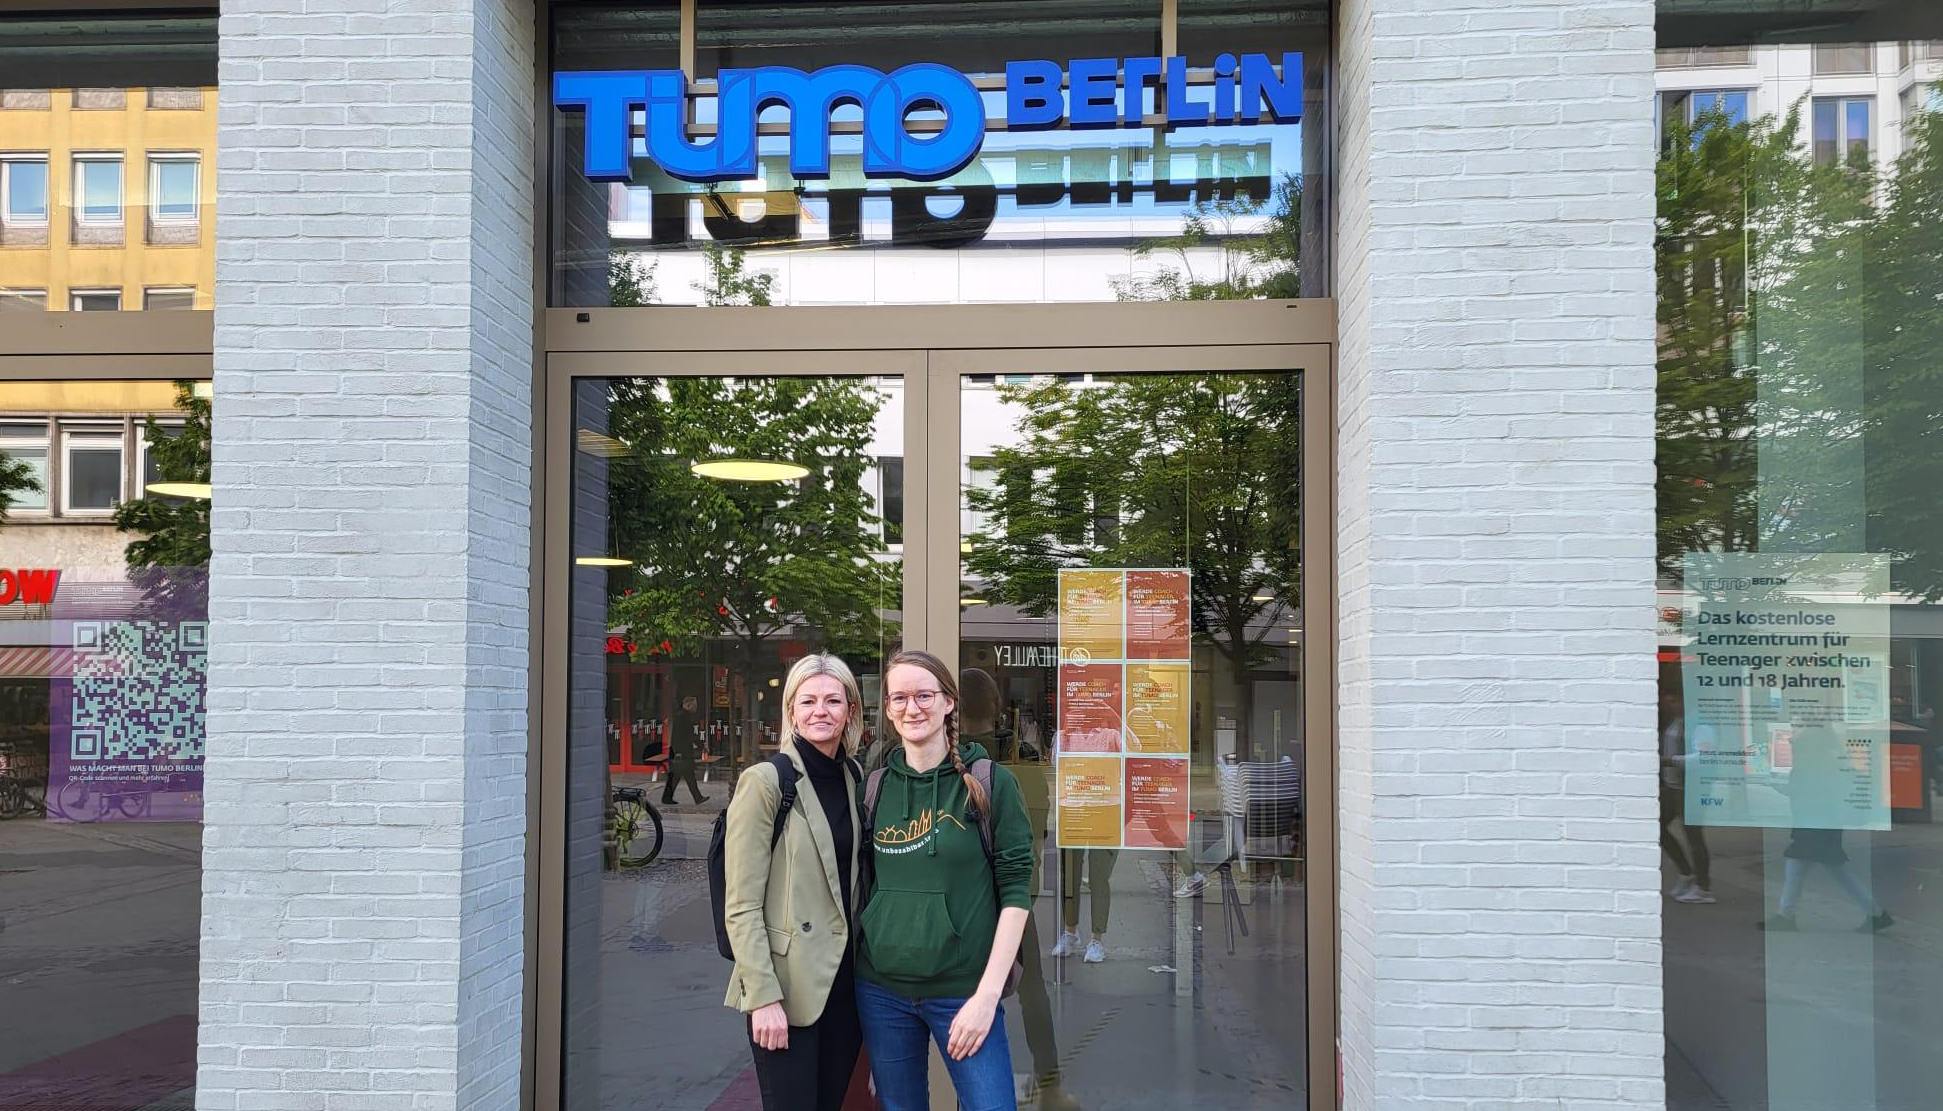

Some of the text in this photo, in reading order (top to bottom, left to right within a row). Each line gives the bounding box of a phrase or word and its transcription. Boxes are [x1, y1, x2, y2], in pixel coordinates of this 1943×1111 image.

[553, 63, 986, 182] TUMO
[1697, 611, 1731, 625] Das
[1736, 611, 1835, 625] kostenlose
[1697, 631, 1850, 648] Lernzentrum für
[1696, 652, 1871, 670] Teenager zwischen
[1696, 673, 1845, 690] 12 und 18 Jahren.
